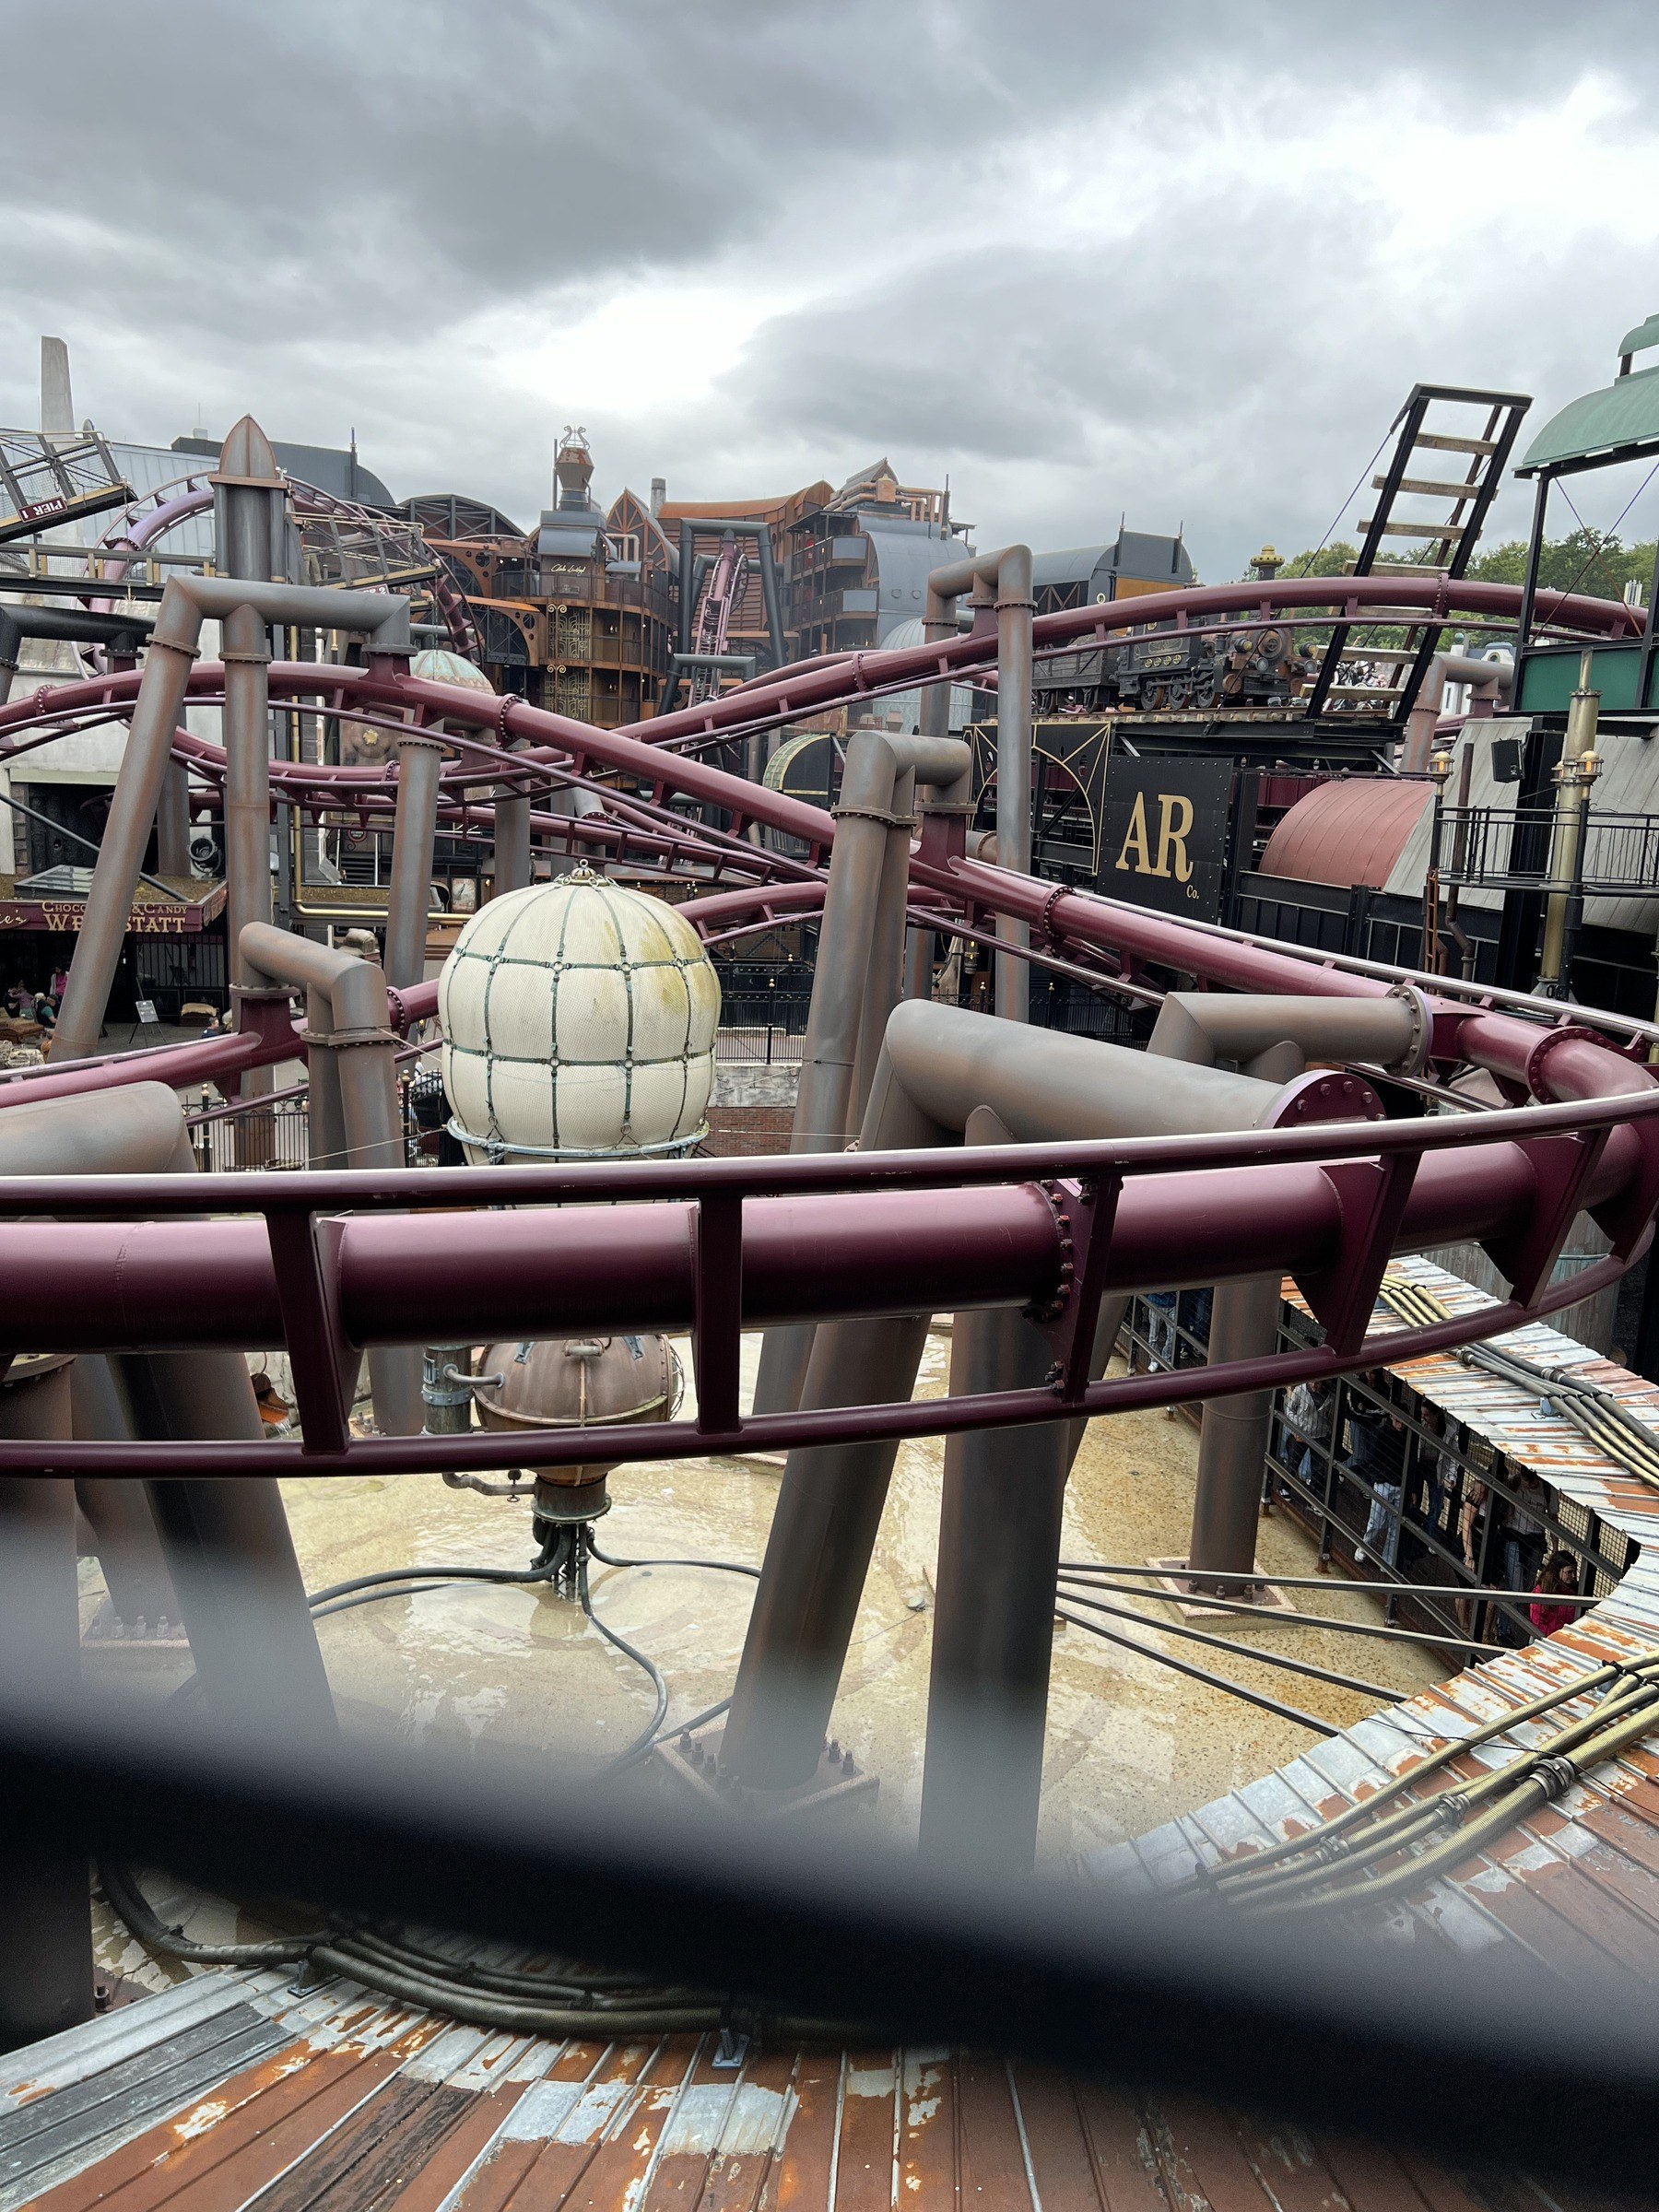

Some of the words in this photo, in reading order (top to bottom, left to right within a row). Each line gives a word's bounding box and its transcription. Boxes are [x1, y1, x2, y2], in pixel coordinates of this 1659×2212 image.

[22, 511, 29, 519] 1
[33, 500, 63, 515] PIER
[1115, 791, 1194, 883] AR
[1186, 884, 1200, 900] Co.
